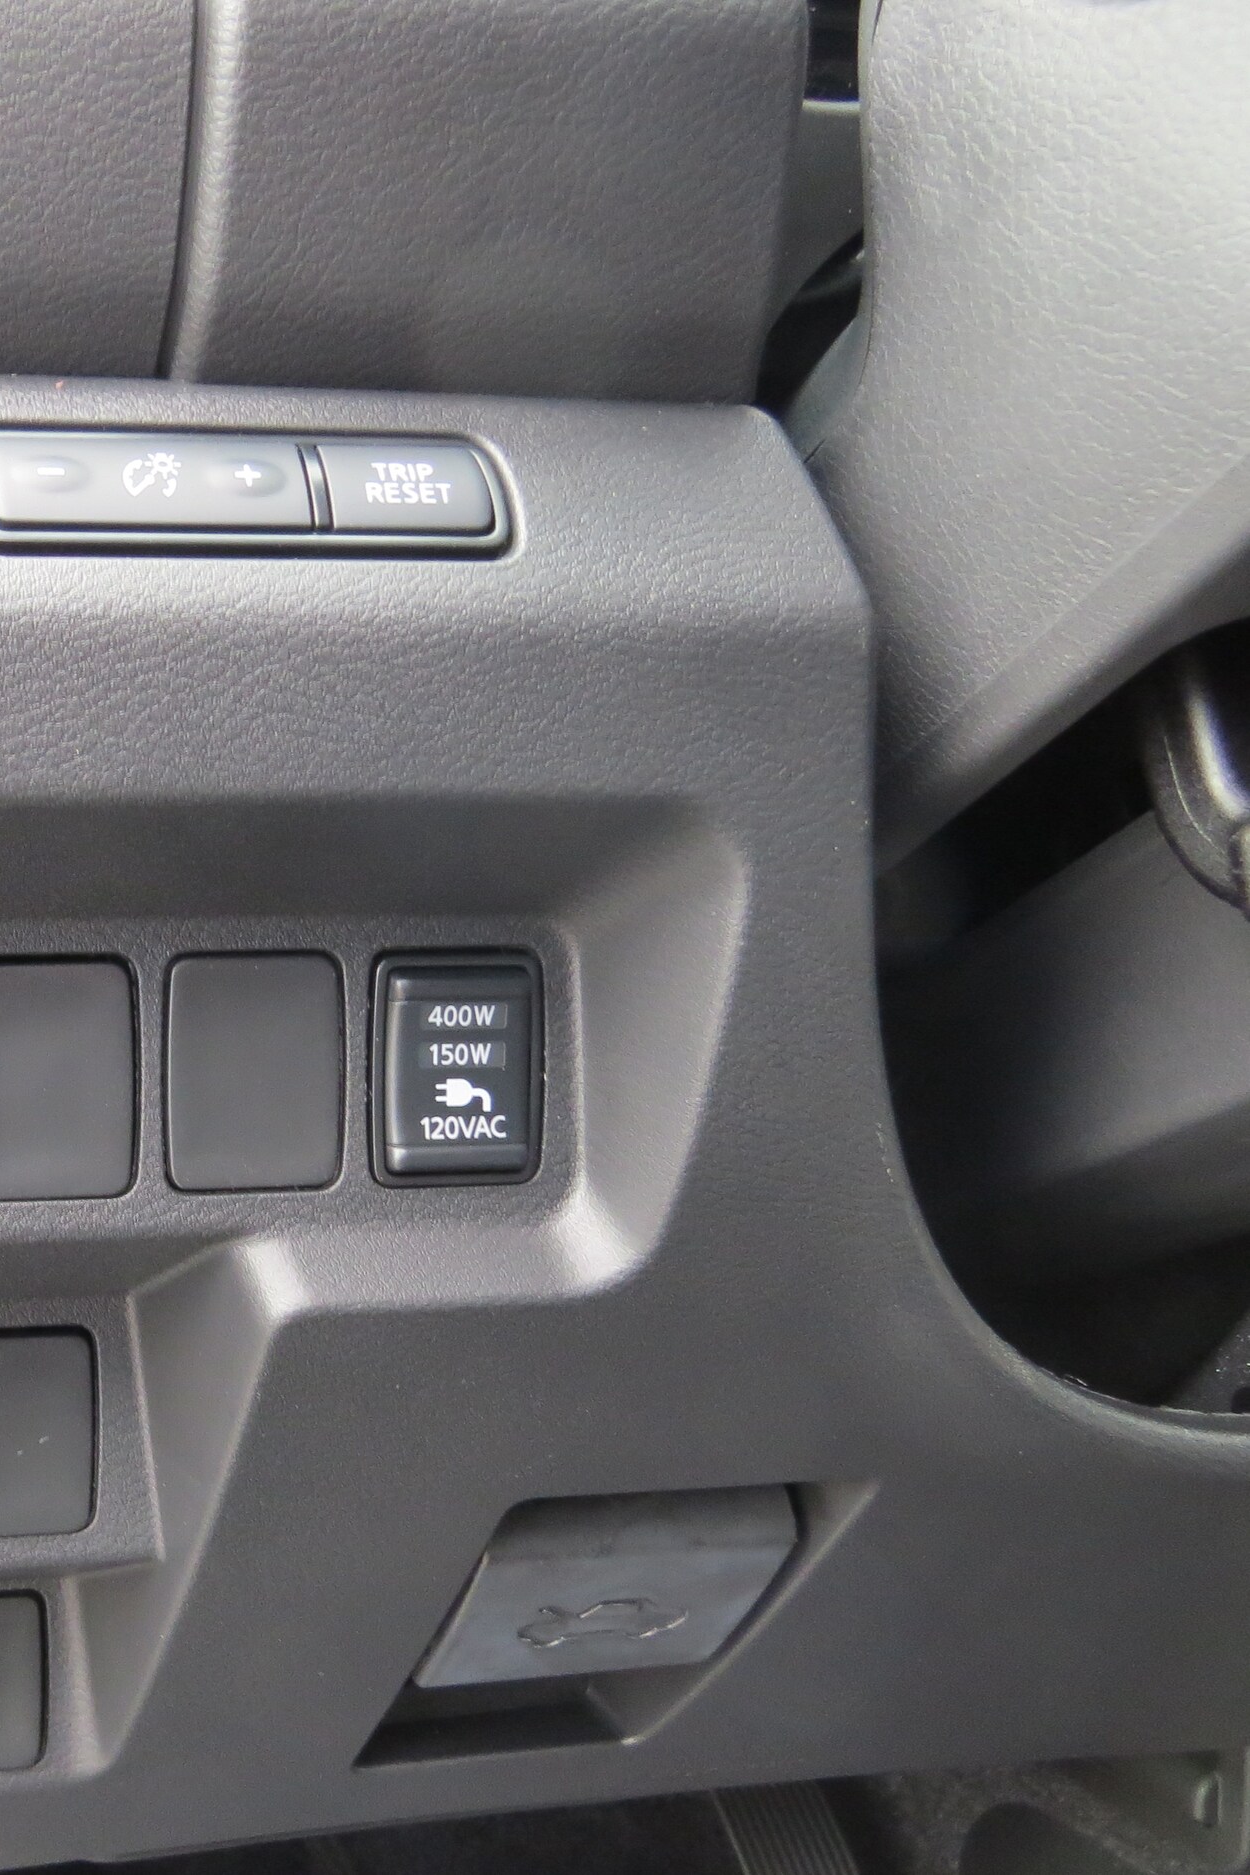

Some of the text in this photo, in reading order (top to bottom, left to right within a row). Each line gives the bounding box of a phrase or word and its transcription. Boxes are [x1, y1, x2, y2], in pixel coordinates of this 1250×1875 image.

[371, 462, 433, 482] TRIP
[365, 481, 451, 503] RESET
[427, 1005, 495, 1026] 400W
[429, 1044, 491, 1065] 150W
[420, 1116, 506, 1139] 120VAC
